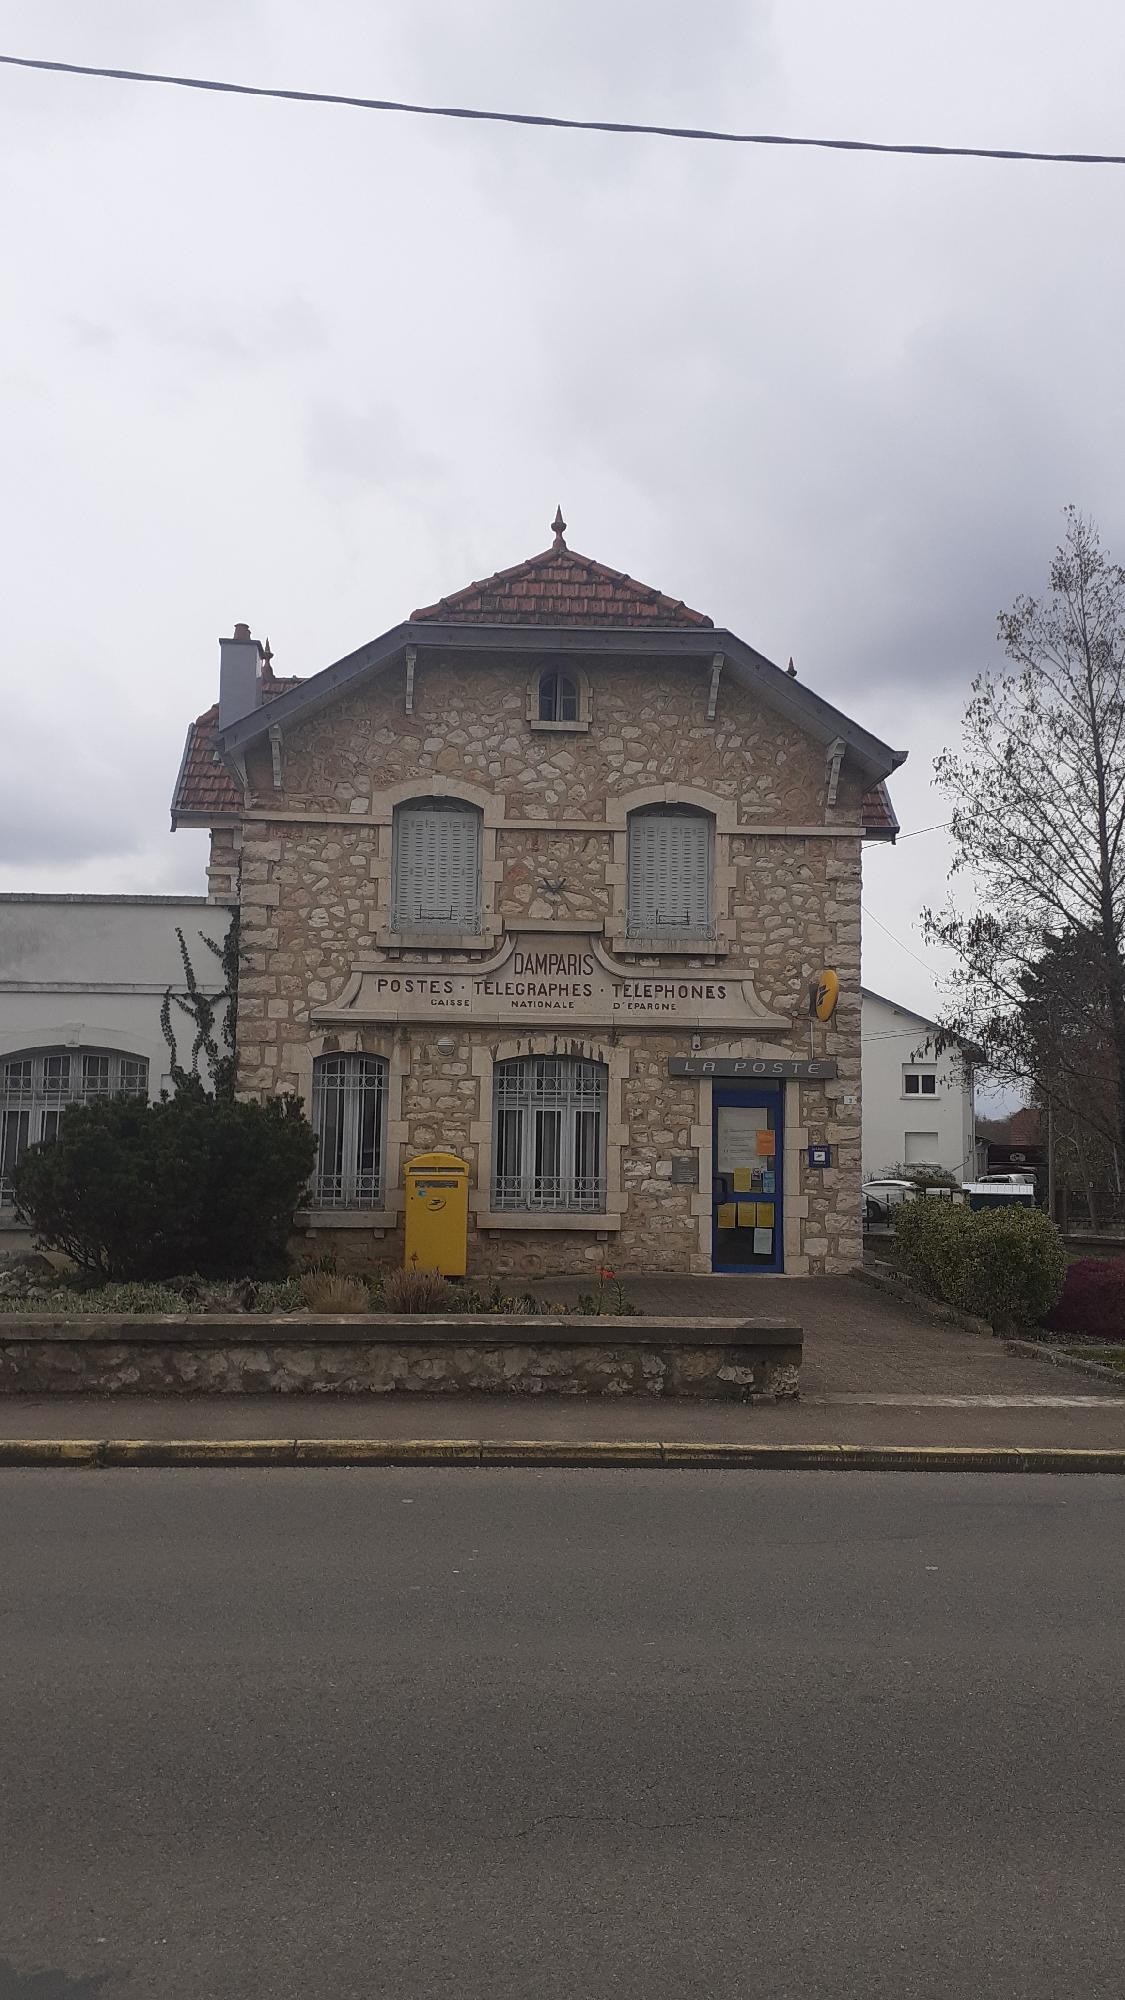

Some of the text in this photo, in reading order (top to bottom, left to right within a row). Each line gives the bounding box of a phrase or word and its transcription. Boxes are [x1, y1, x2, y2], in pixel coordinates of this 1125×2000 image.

[514, 952, 594, 976] DAMPARIS
[377, 979, 727, 999] POSTES TELEGRAPHES TELEPHONES
[430, 999, 470, 1007] CAISSE
[511, 1000, 575, 1009] NATIONALE
[684, 1061, 821, 1074] LA POSTE
